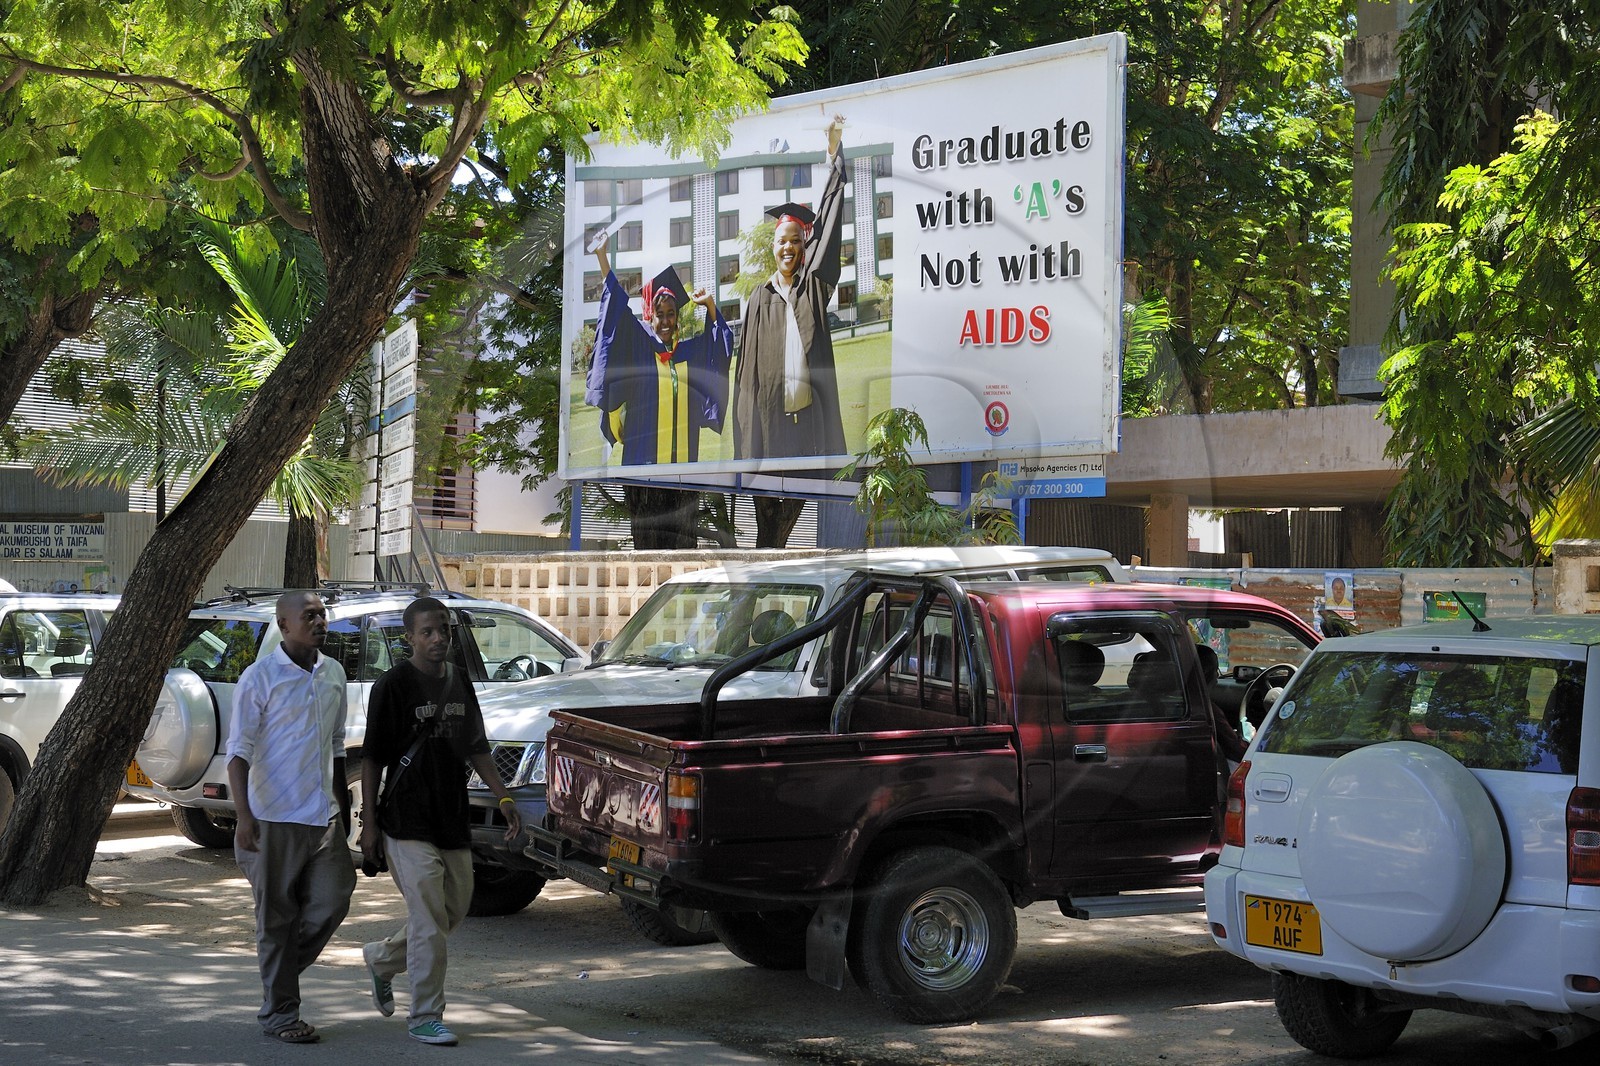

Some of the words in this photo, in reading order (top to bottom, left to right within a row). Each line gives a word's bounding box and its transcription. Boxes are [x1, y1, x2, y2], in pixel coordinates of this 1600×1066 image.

[911, 117, 1091, 171] Graduate
[915, 187, 994, 229] with
[920, 250, 982, 288] Not
[997, 240, 1082, 283] with
[959, 305, 1051, 345] AIDS
[1020, 464, 1045, 474] Masoko
[1046, 463, 1078, 474] Agencies
[1079, 463, 1089, 473] (T)
[1090, 463, 1103, 471] Ltd
[1018, 484, 1042, 495] 0767
[1044, 483, 1063, 495] 300
[1064, 482, 1083, 494] 300
[13, 524, 50, 535] MUSEUM
[54, 524, 65, 535] OF
[70, 524, 105, 535] TANZANI
[54, 536, 64, 547] YA
[66, 536, 88, 547] TAIFA
[4, 547, 21, 558] DAR
[24, 547, 36, 558] ES
[39, 548, 73, 559] SALAAM
[1273, 926, 1303, 948] AUF
